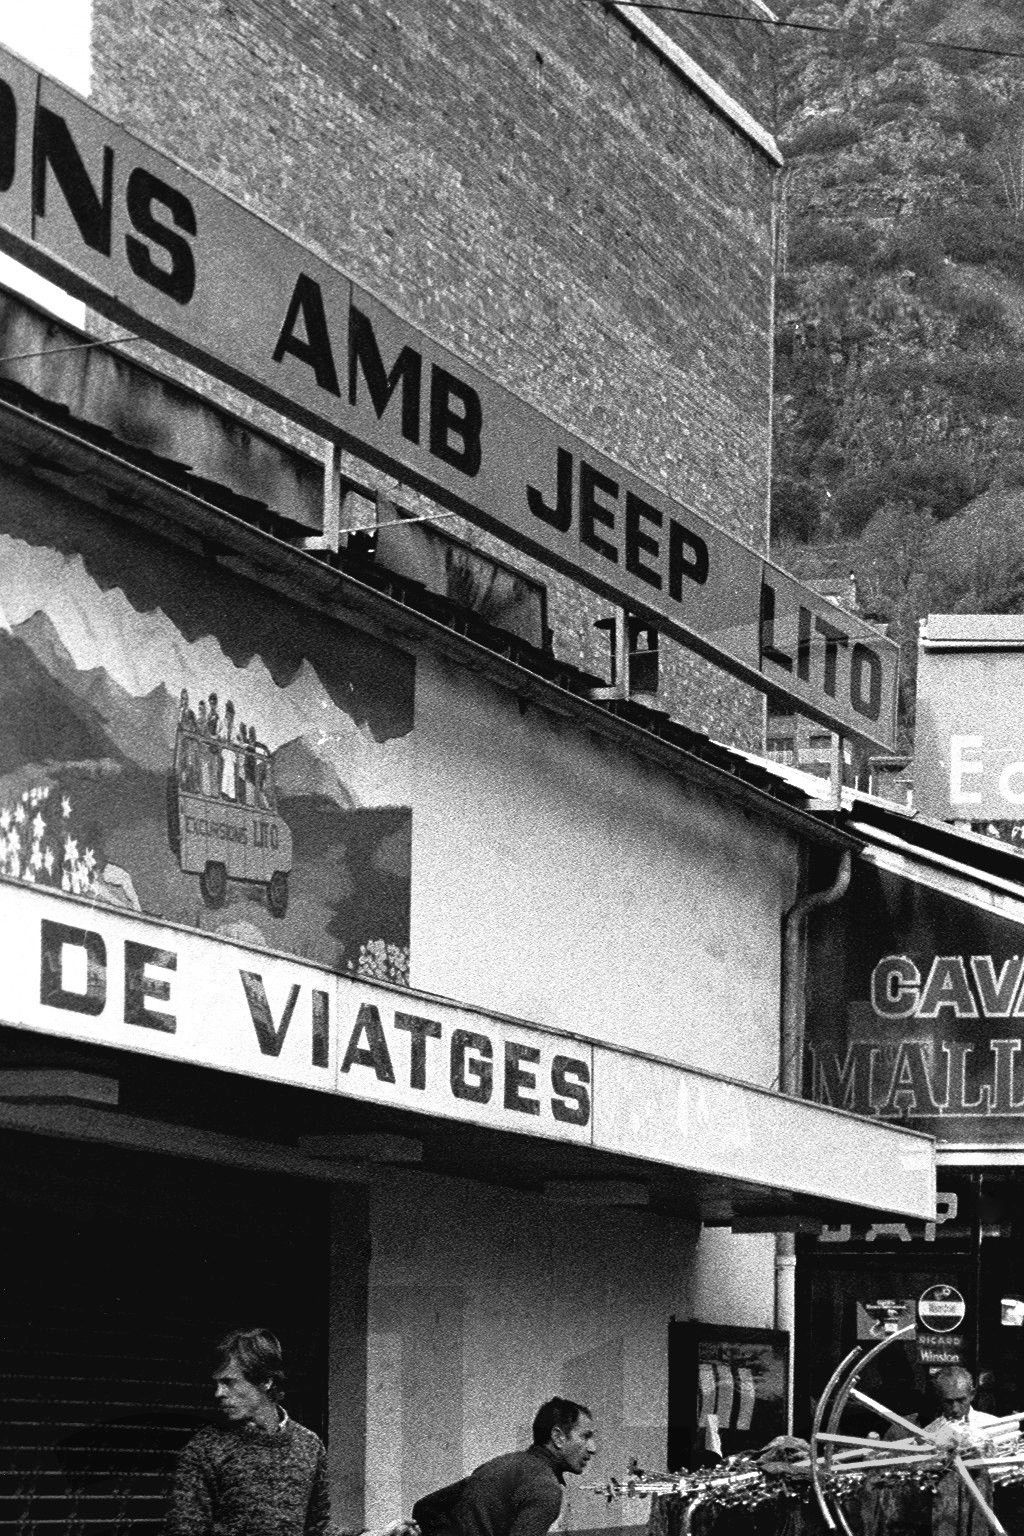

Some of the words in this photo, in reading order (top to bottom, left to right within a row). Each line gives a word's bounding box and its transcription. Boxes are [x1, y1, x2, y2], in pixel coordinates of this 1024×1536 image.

[0, 78, 196, 305] NS
[272, 273, 482, 477] AMB
[526, 447, 709, 603] JEEP
[761, 582, 881, 722] LITO
[41, 918, 177, 1034] DE
[239, 969, 592, 1128] VIATGES
[920, 1350, 960, 1363] Winston
